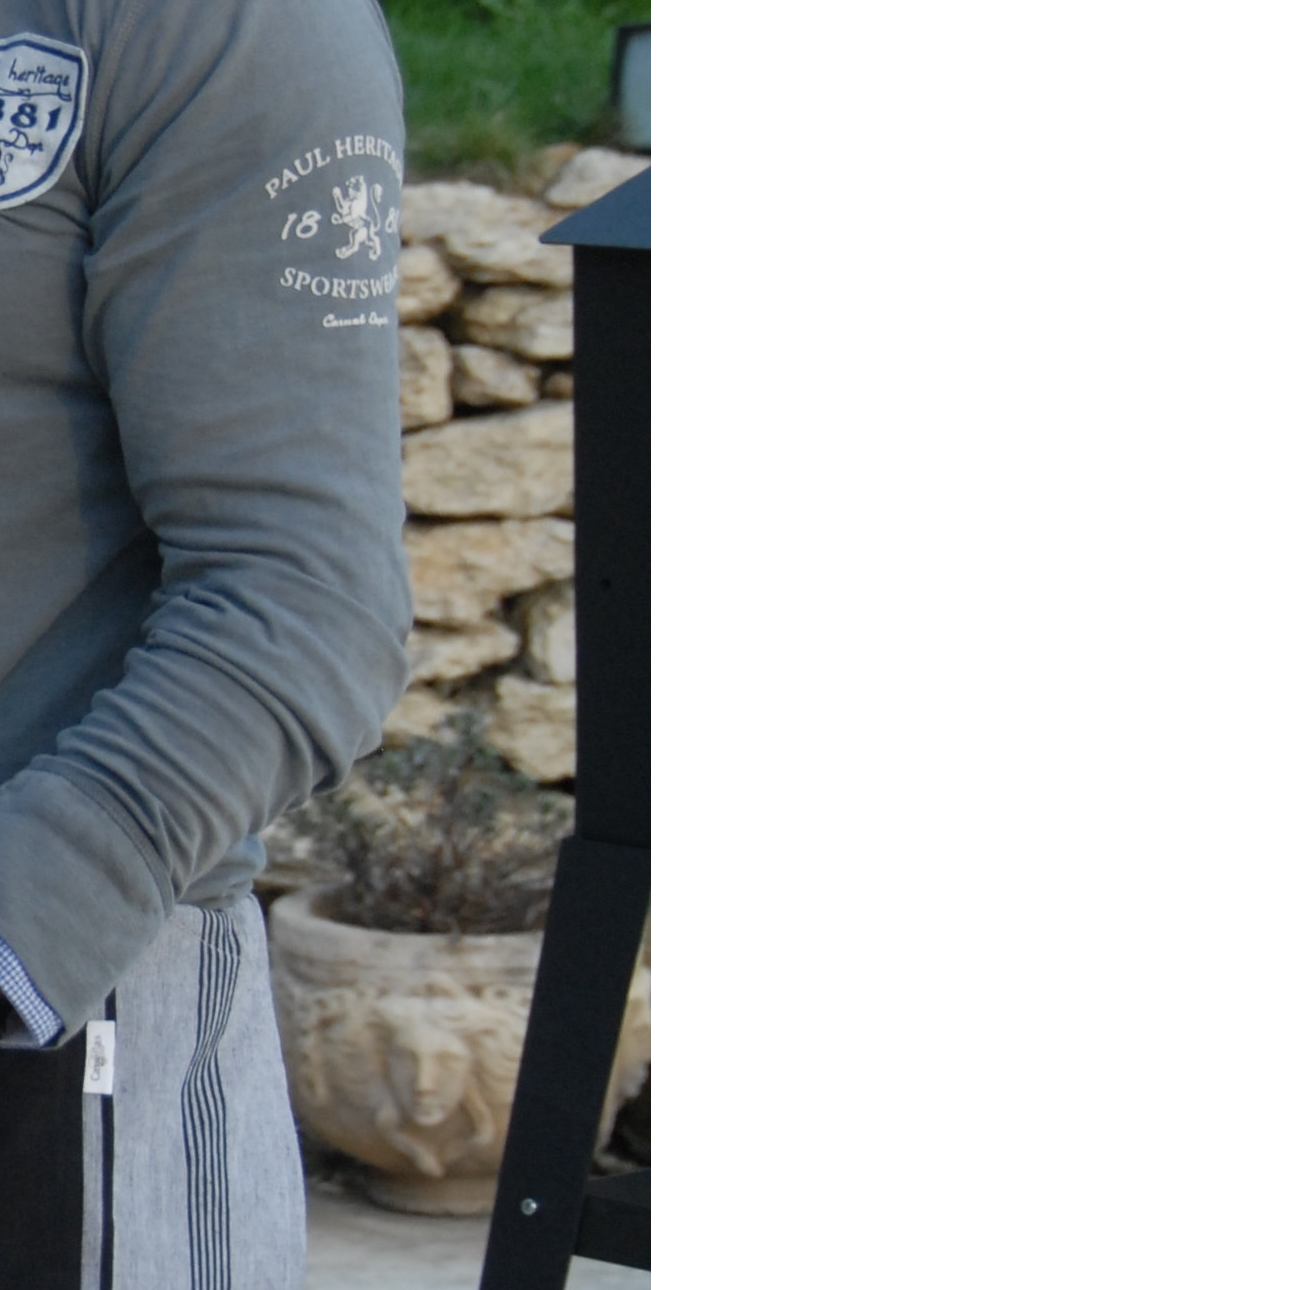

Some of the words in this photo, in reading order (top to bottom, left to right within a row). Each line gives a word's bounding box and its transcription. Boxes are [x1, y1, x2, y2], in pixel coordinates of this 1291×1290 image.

[7, 58, 72, 93] heritage
[264, 147, 331, 200] PAUL
[280, 210, 322, 241] 18
